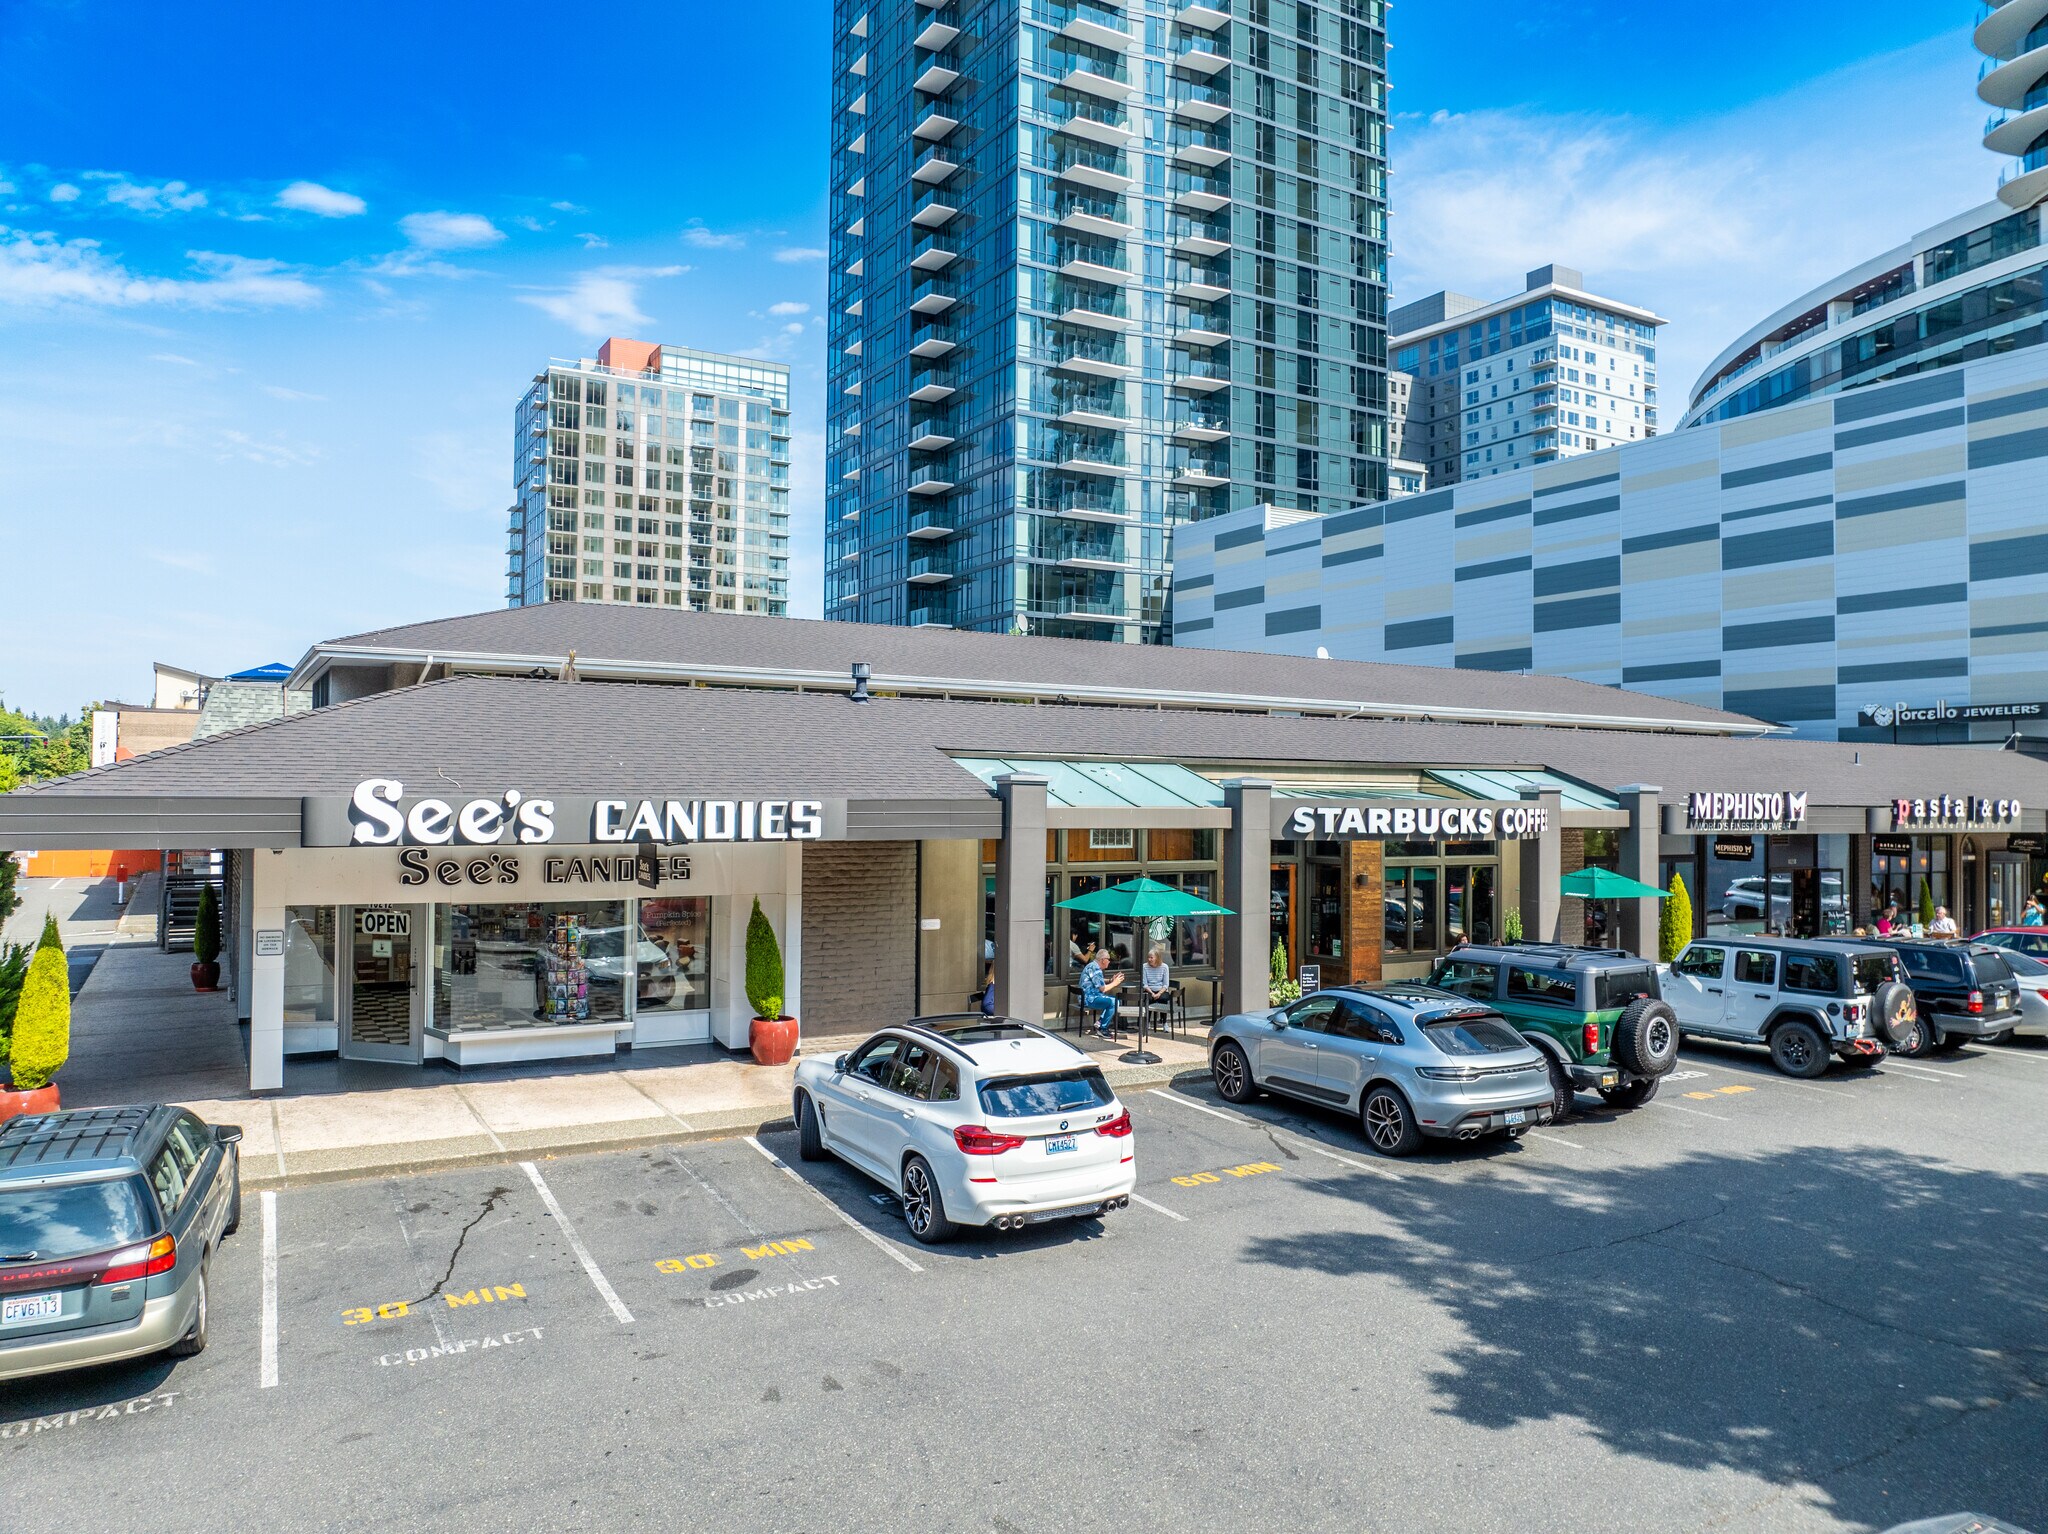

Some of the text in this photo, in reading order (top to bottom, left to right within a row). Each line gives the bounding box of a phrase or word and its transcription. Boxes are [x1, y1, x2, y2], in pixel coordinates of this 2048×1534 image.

[1896, 700, 2040, 725] Porcello JEWELERS
[353, 778, 823, 844] See's CANDIES
[1293, 807, 1493, 834] STARBUCKS
[1695, 792, 1807, 821] MEPHISTO M
[1898, 795, 2021, 824] pasta & co
[1698, 823, 1729, 831] WORLD'S
[1731, 823, 1753, 831] FINEST
[399, 848, 519, 885] See's
[365, 914, 407, 933] OPEN
[1170, 1161, 1283, 1187] 60 MIN
[740, 1238, 816, 1260] MIN
[3, 1267, 73, 1281] UBARU
[341, 1283, 527, 1325] 30 MIN
[704, 1275, 840, 1308] COMPACT
[5, 1300, 58, 1319] CFV6113
[379, 1327, 545, 1367] COMPACT
[0, 1392, 181, 1439] OMPACT
